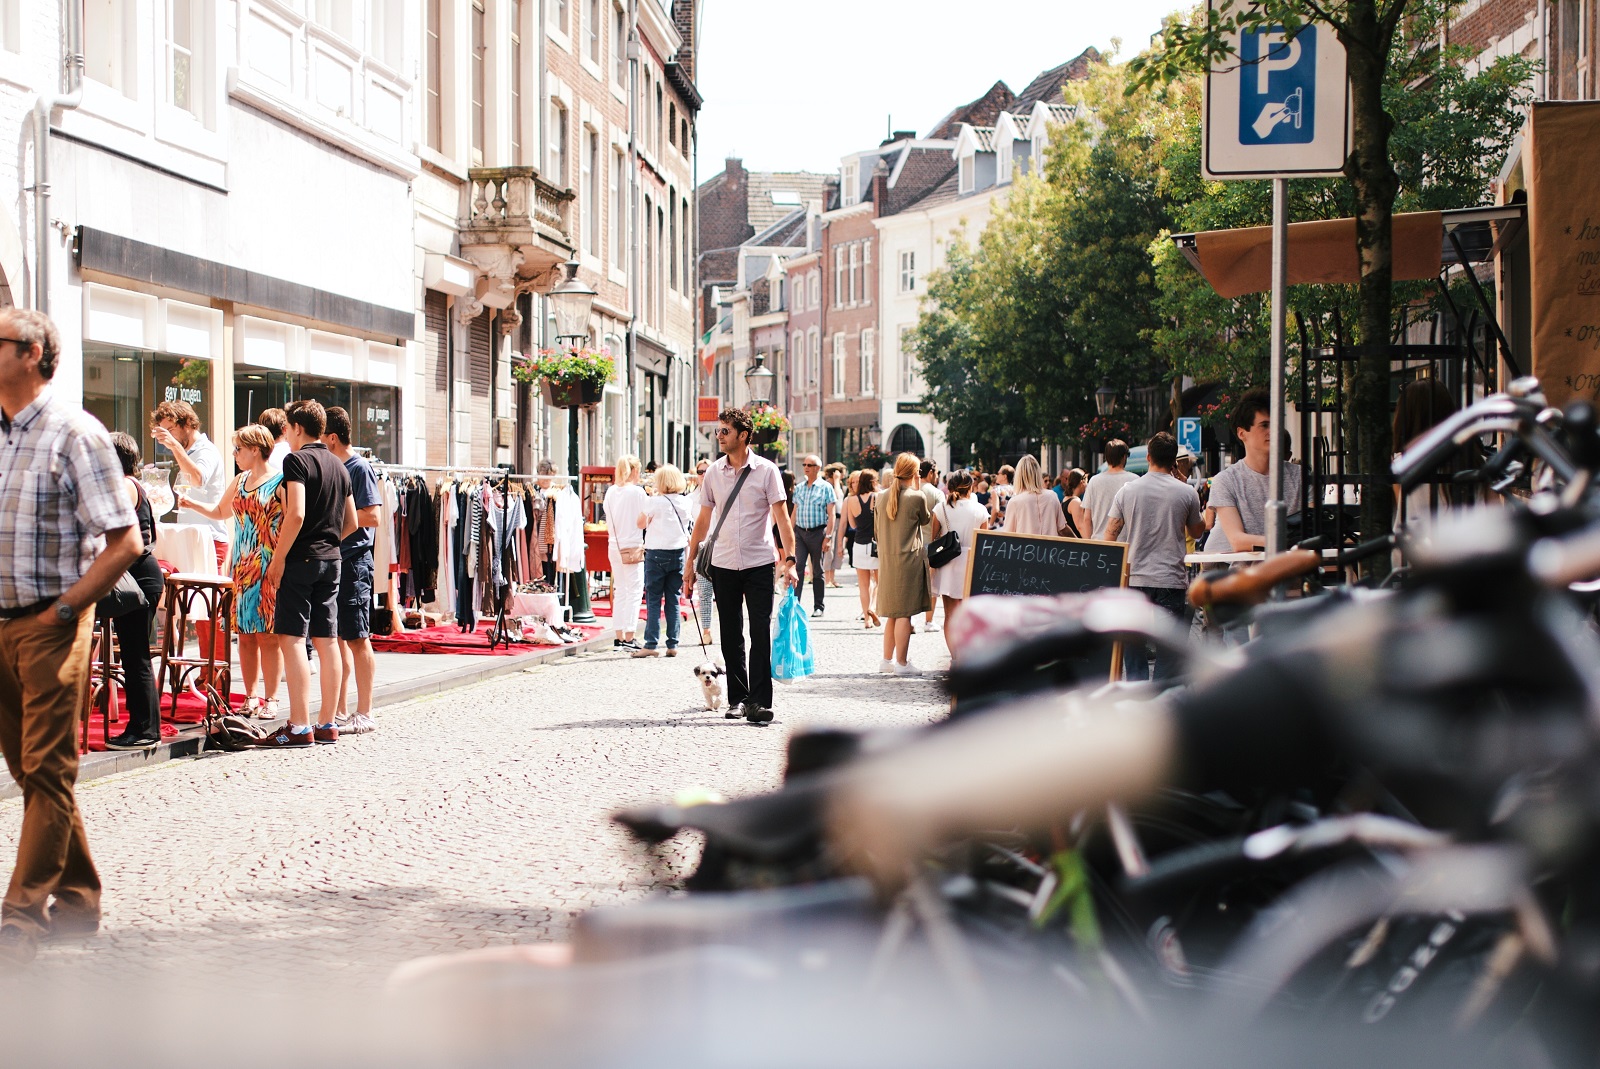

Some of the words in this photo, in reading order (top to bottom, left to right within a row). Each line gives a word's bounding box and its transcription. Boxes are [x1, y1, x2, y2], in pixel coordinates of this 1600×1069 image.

[1257, 32, 1302, 94] P
[1183, 420, 1197, 439] P
[980, 539, 1090, 567] HAMBURGER
[1096, 553, 1118, 574] 5,-
[979, 561, 1012, 583] NEW
[1016, 567, 1051, 592] YORK
